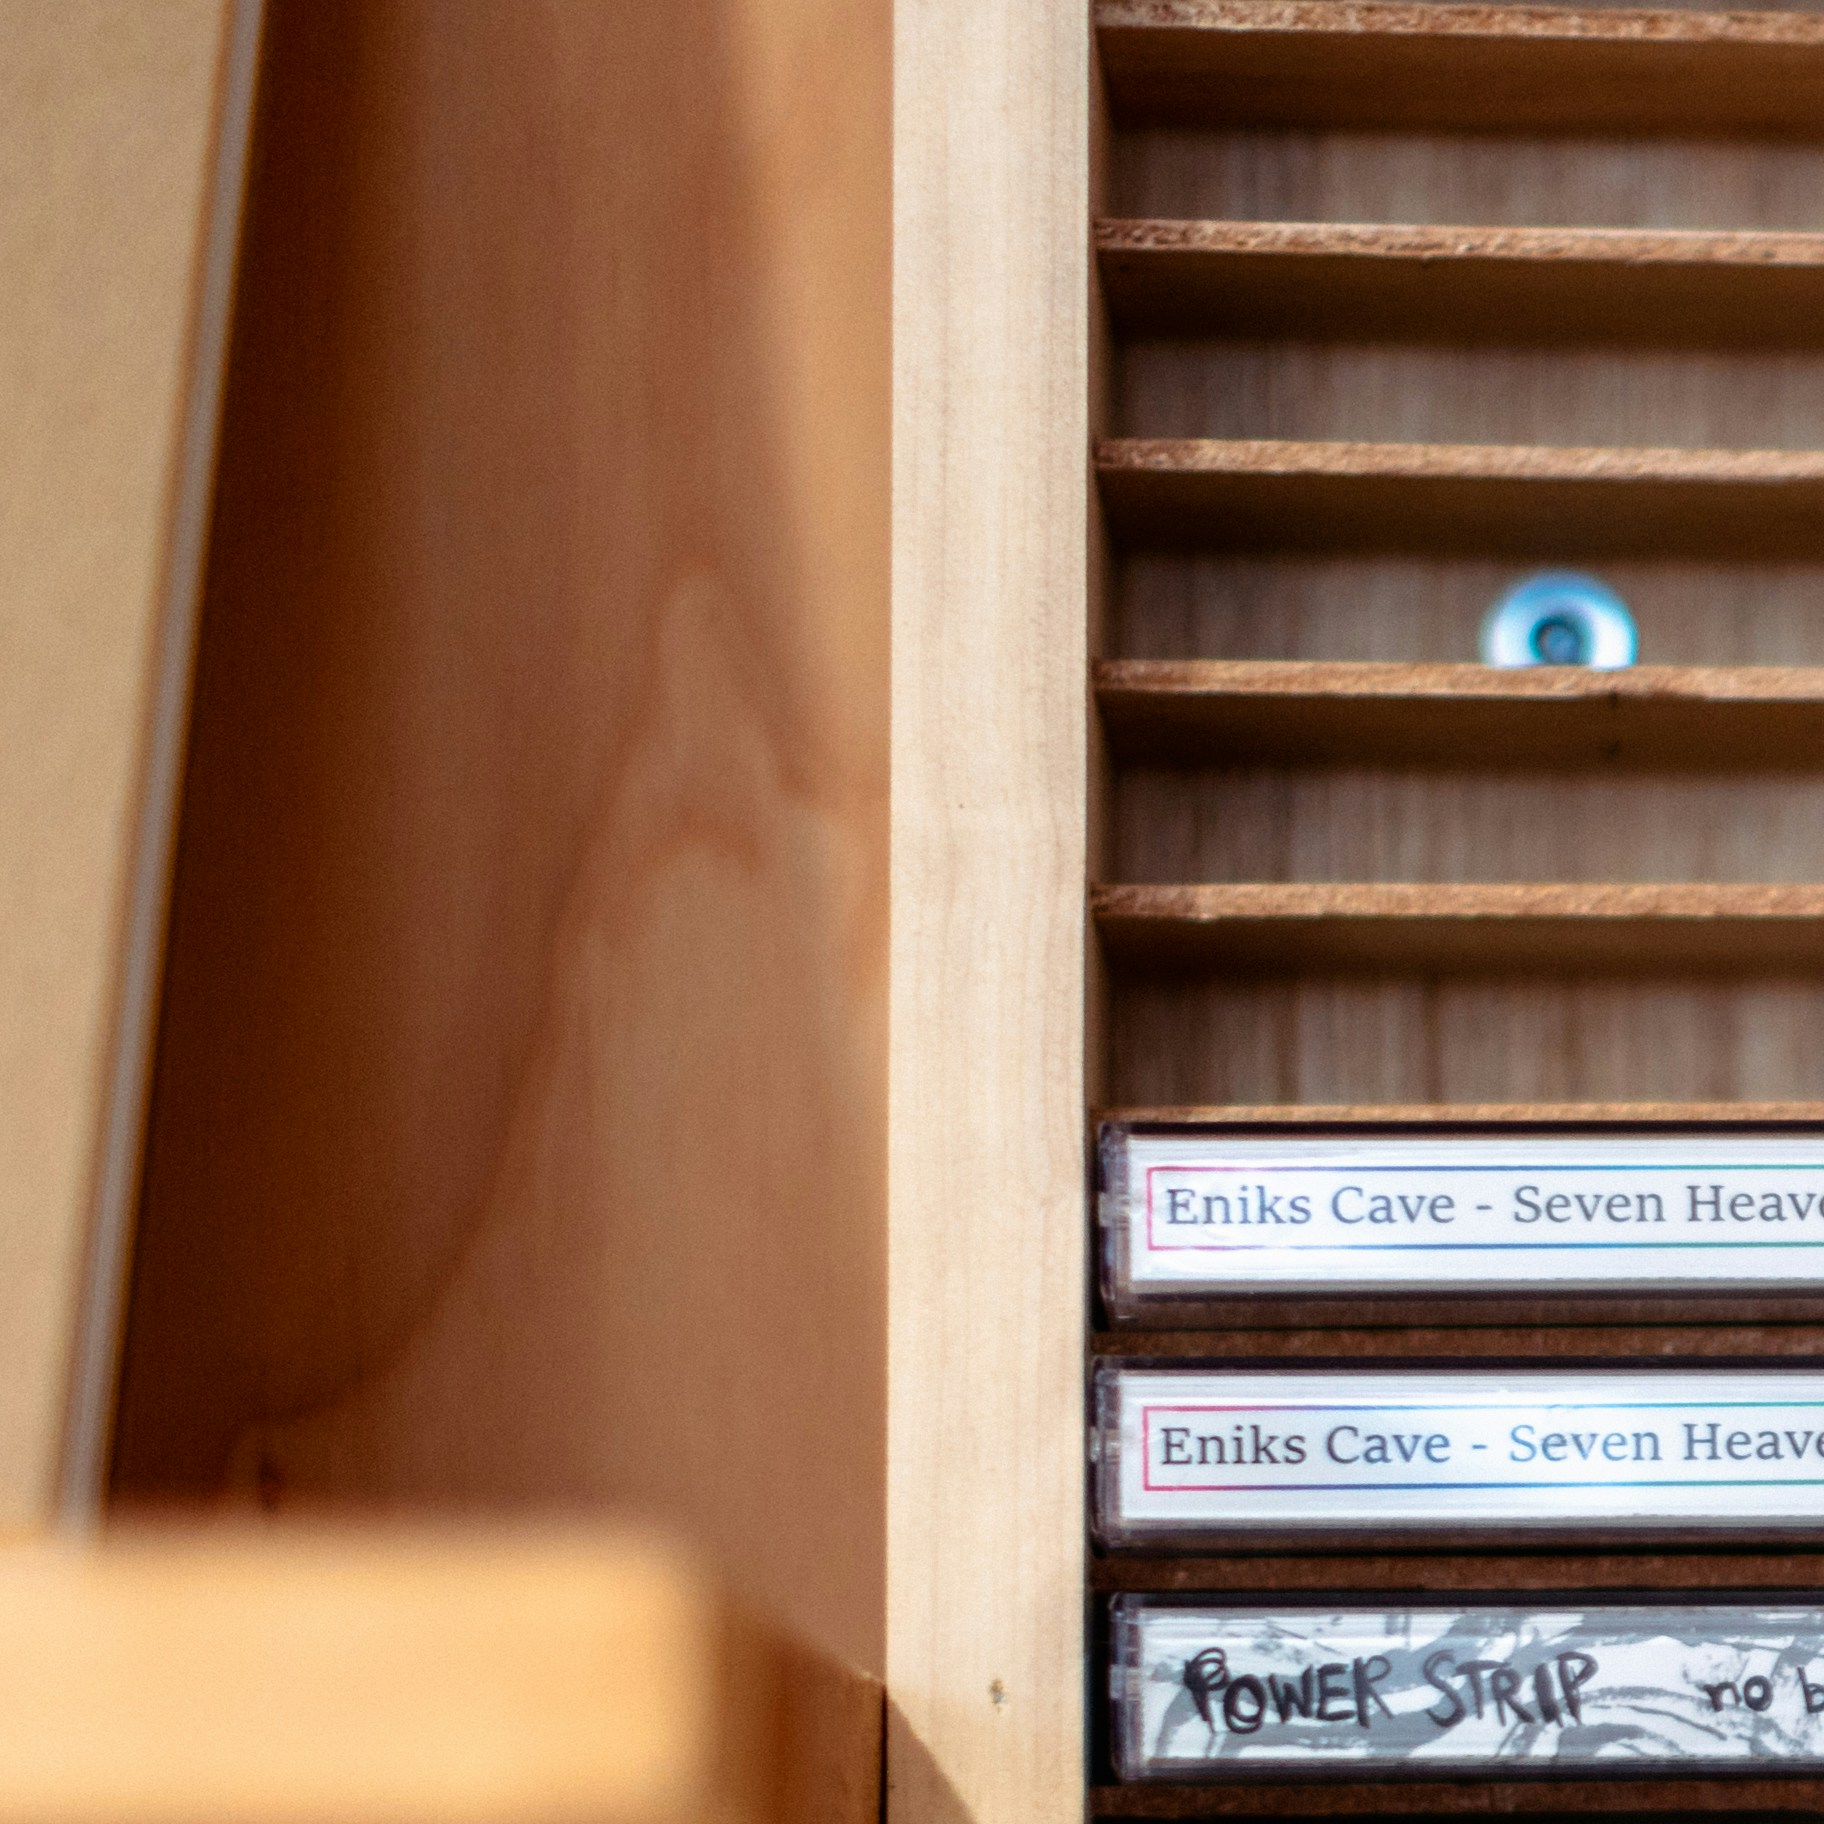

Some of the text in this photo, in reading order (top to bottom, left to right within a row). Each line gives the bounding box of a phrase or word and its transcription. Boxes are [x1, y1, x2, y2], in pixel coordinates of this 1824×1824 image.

[1165, 1185, 1312, 1225] Eniks
[1330, 1186, 1456, 1224] Cave
[1512, 1185, 1667, 1224] Seven
[1159, 1425, 1308, 1466] Eniks
[1325, 1425, 1451, 1464] Cave
[1508, 1424, 1661, 1463] Seven
[1184, 1646, 1599, 1734] POWER STRIP
[1704, 1675, 1773, 1713] no
